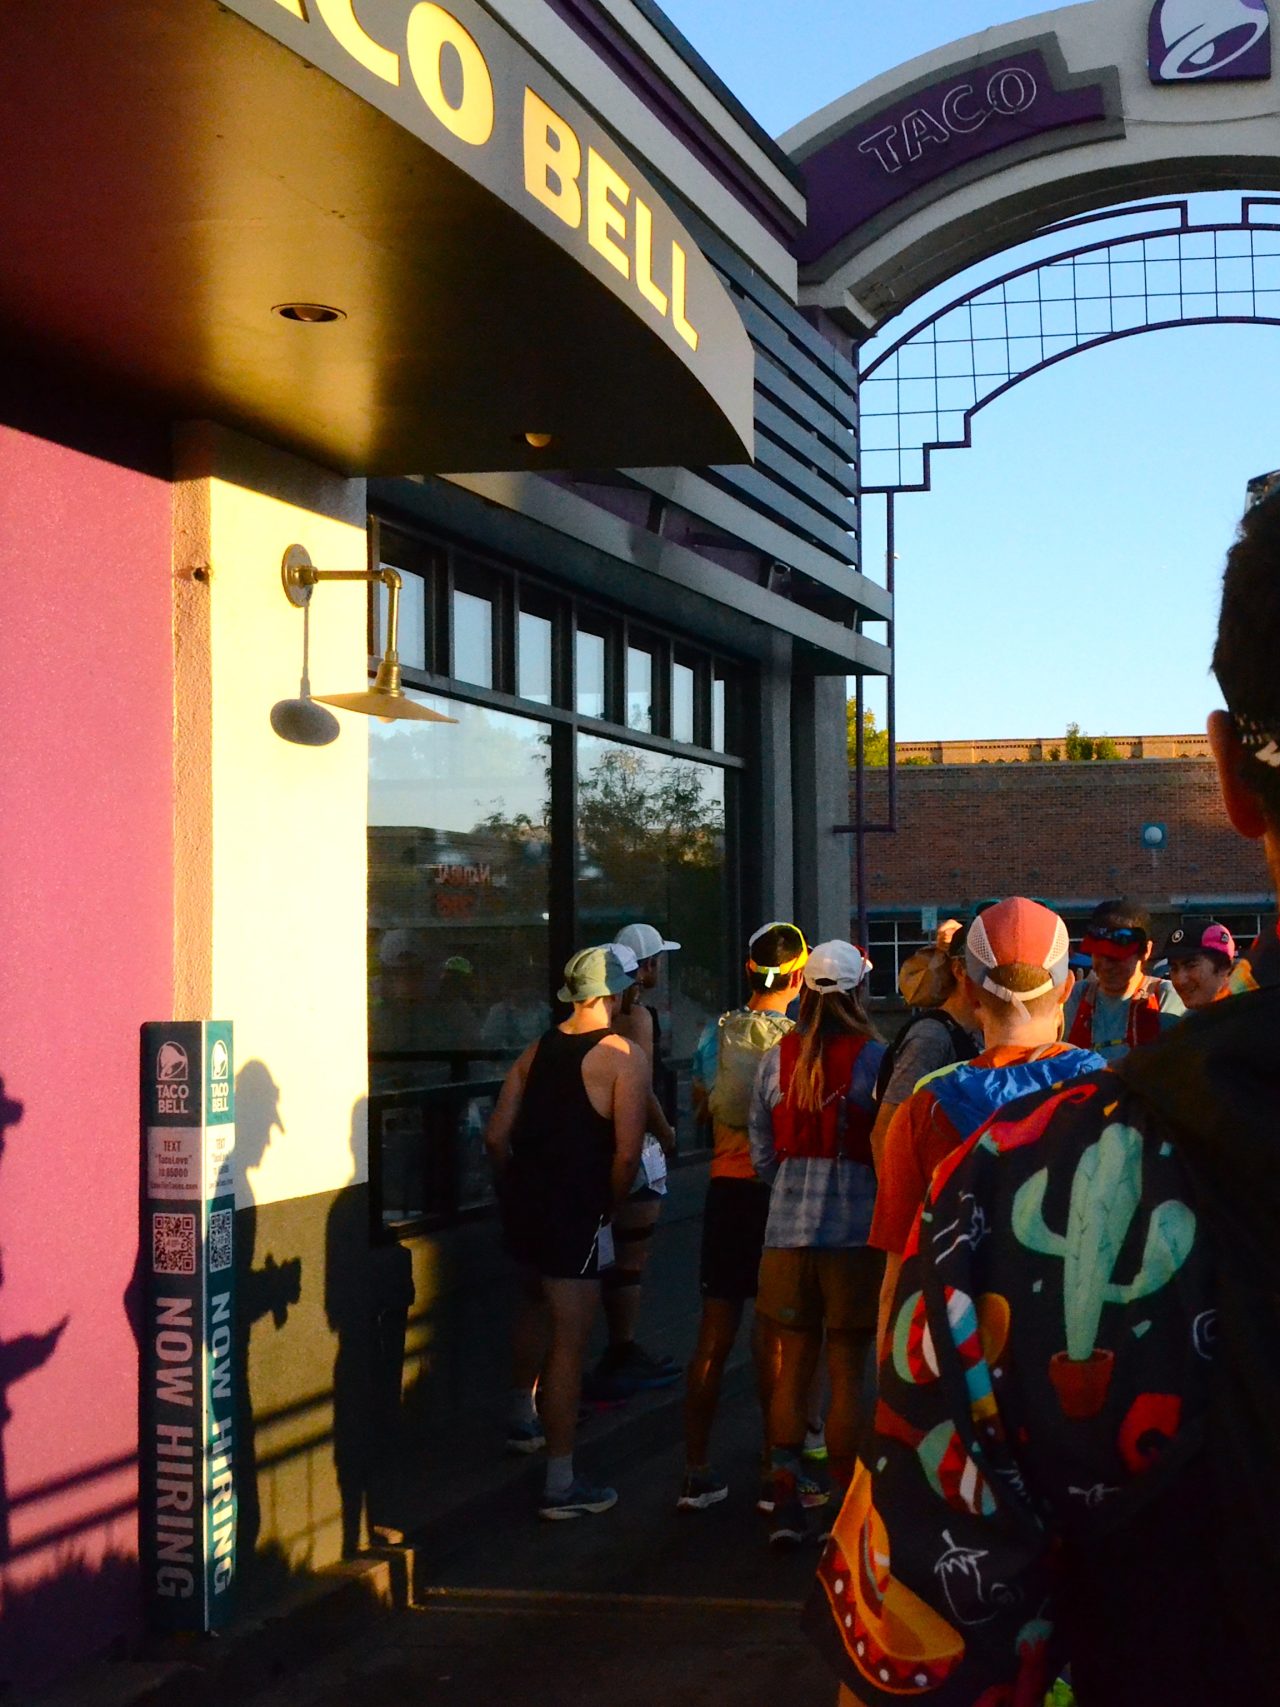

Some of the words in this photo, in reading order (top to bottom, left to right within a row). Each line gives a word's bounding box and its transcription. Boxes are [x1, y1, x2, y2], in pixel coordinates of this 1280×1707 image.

[859, 67, 1037, 174] TACO
[523, 85, 698, 352] BELL
[156, 1084, 189, 1099] TACO
[158, 1099, 189, 1114] BELL
[210, 1082, 229, 1097] TACO
[211, 1097, 229, 1112] BELL
[163, 1140, 181, 1152] TEXT
[157, 1298, 193, 1406] NOW
[211, 1292, 231, 1398] NOW
[157, 1424, 194, 1598] HIRING
[211, 1416, 234, 1595] HIRING
